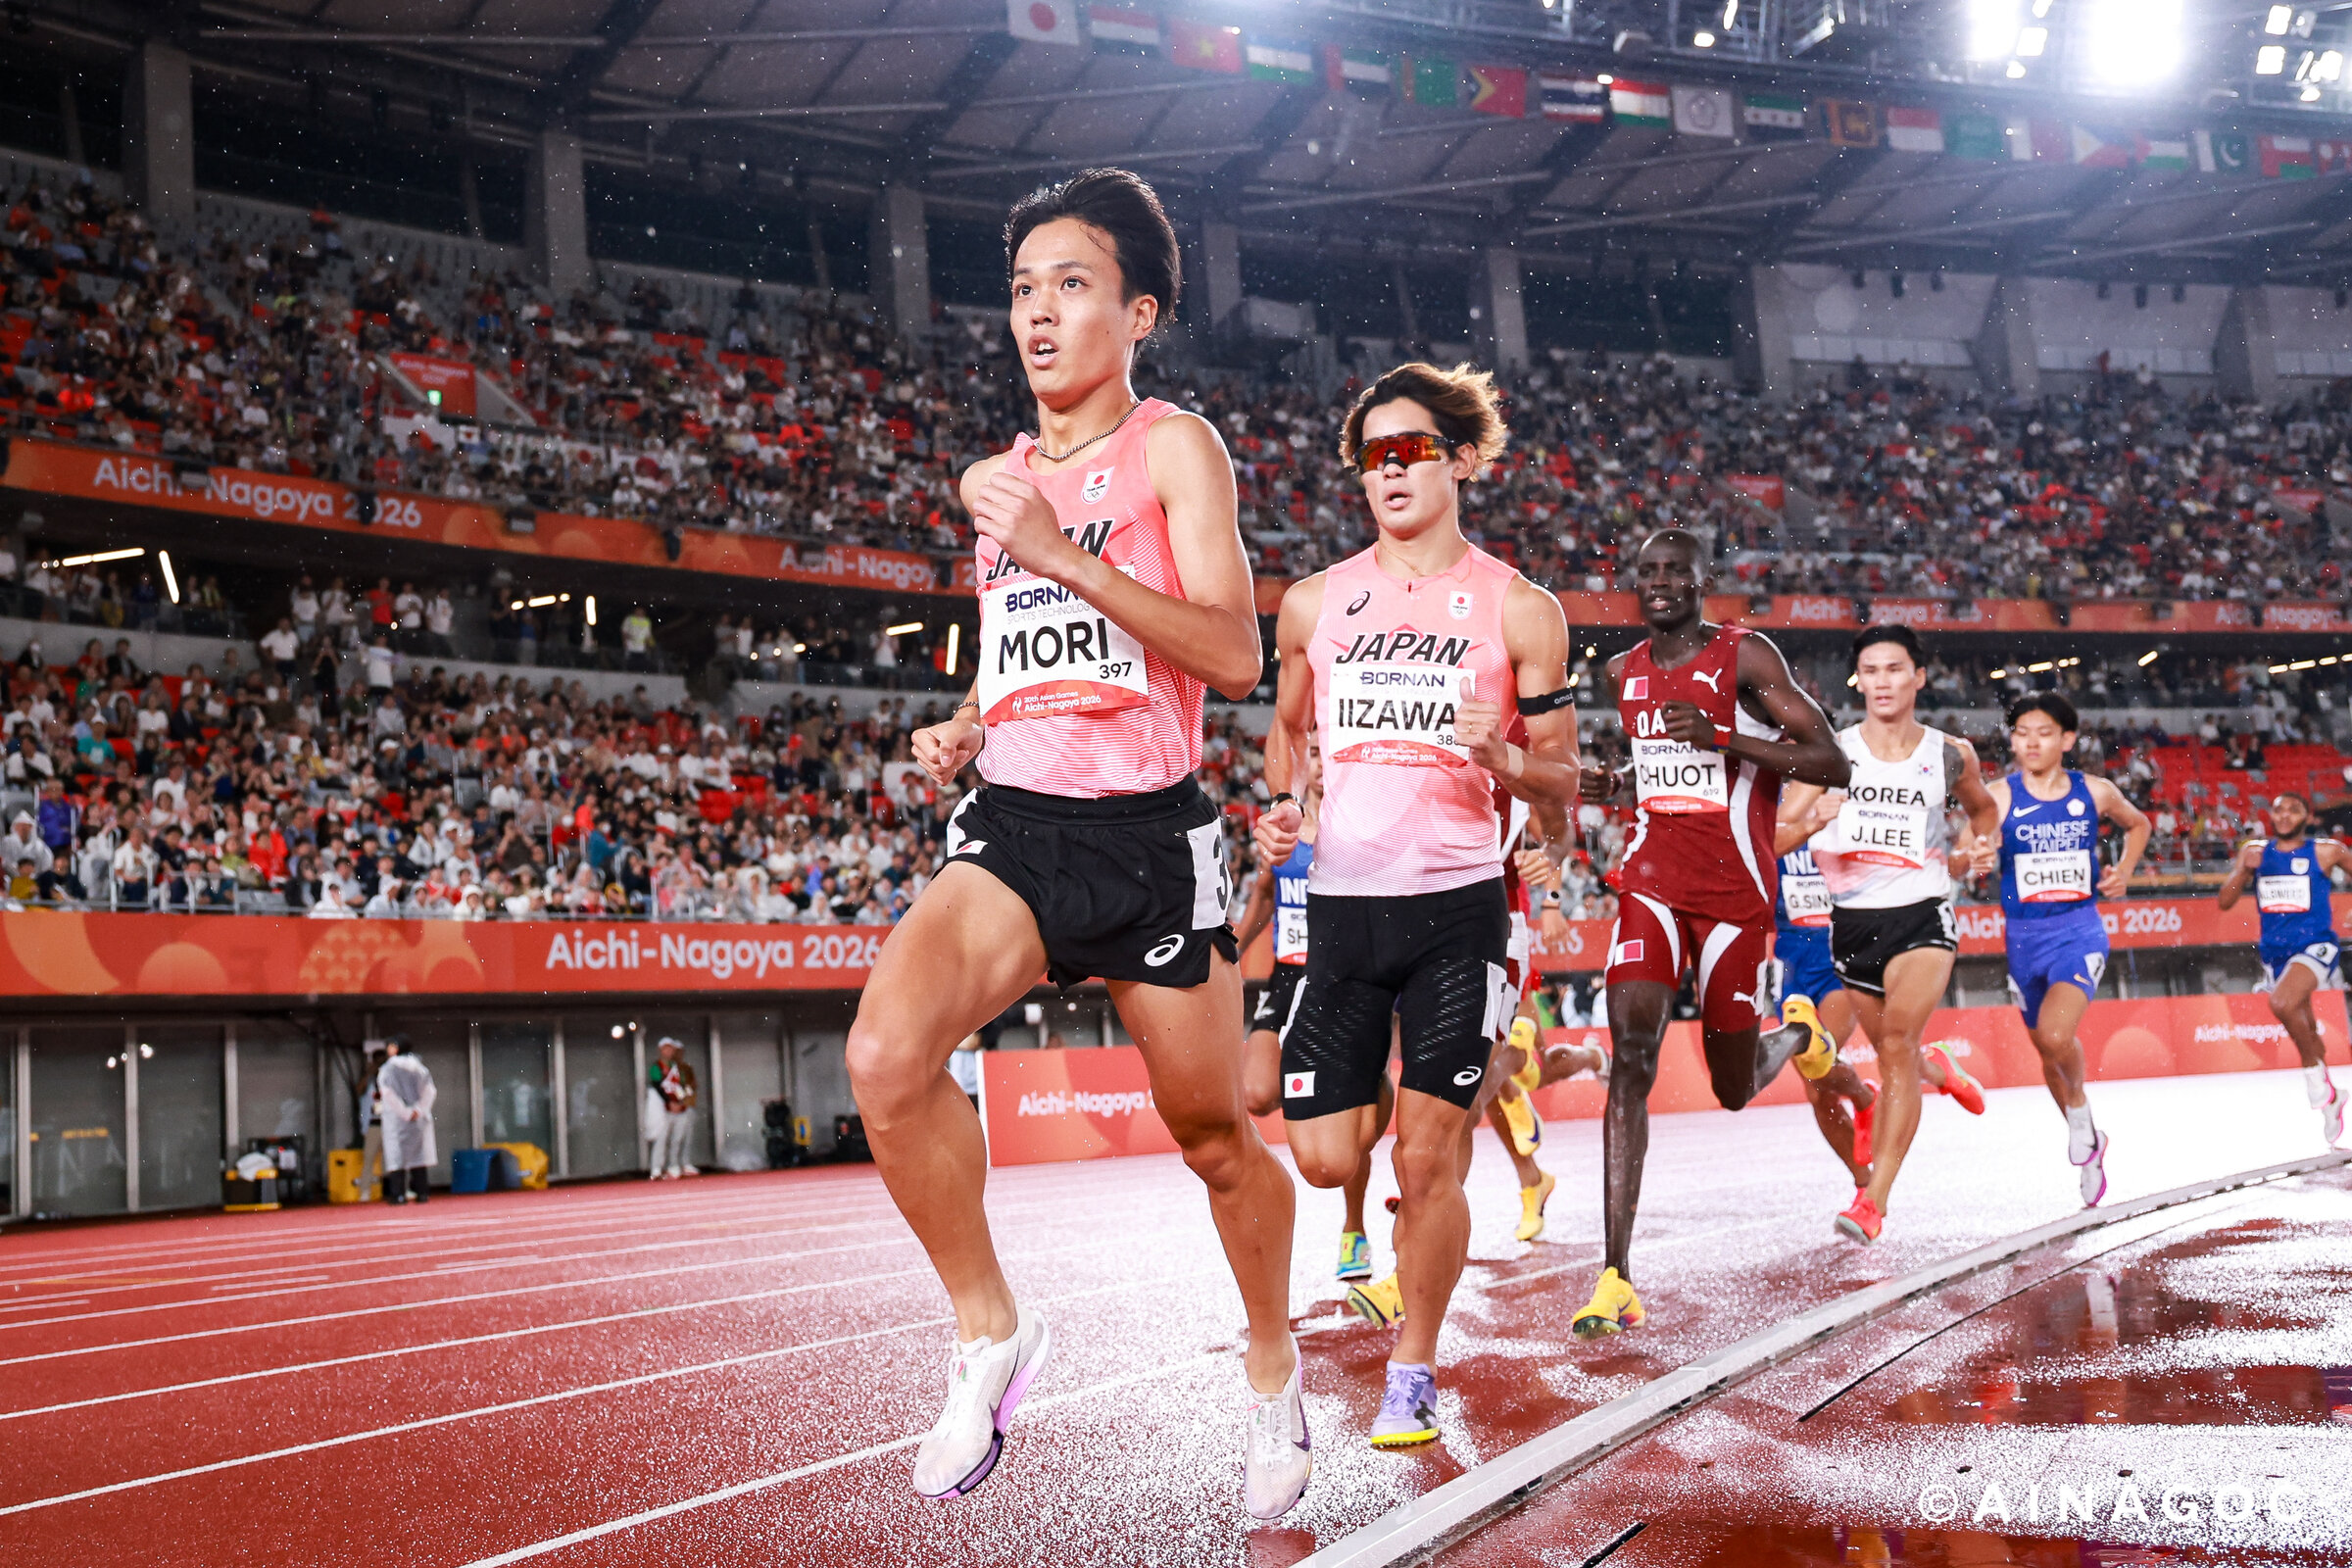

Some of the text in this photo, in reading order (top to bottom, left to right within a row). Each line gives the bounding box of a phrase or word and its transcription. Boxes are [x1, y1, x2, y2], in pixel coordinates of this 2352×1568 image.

[94, 457, 422, 528] AichNagoya 226
[985, 518, 1114, 583] JAN
[1004, 584, 1082, 612] BORN
[1037, 602, 1095, 619] TECHNOLOG
[999, 617, 1109, 674] MORI
[1335, 632, 1471, 667] JAPAN
[1099, 662, 1133, 679] 397
[1359, 671, 1446, 687] BORNAN
[1024, 695, 1102, 712] Aichi-Nagoya 2026
[1040, 693, 1055, 702] Asian
[1339, 698, 1455, 731] IIZAWA
[1640, 763, 1717, 787] CHUOT
[1848, 786, 1926, 808] KOREA
[1851, 825, 1912, 848] J.LEE
[2015, 819, 2090, 841] CHINESE
[2024, 868, 2085, 886] CHIEN
[2124, 906, 2182, 934] 2026
[546, 928, 880, 979] Aichi-Nagoya 2026
[1016, 1090, 1146, 1118] Aichi-Nagoya
